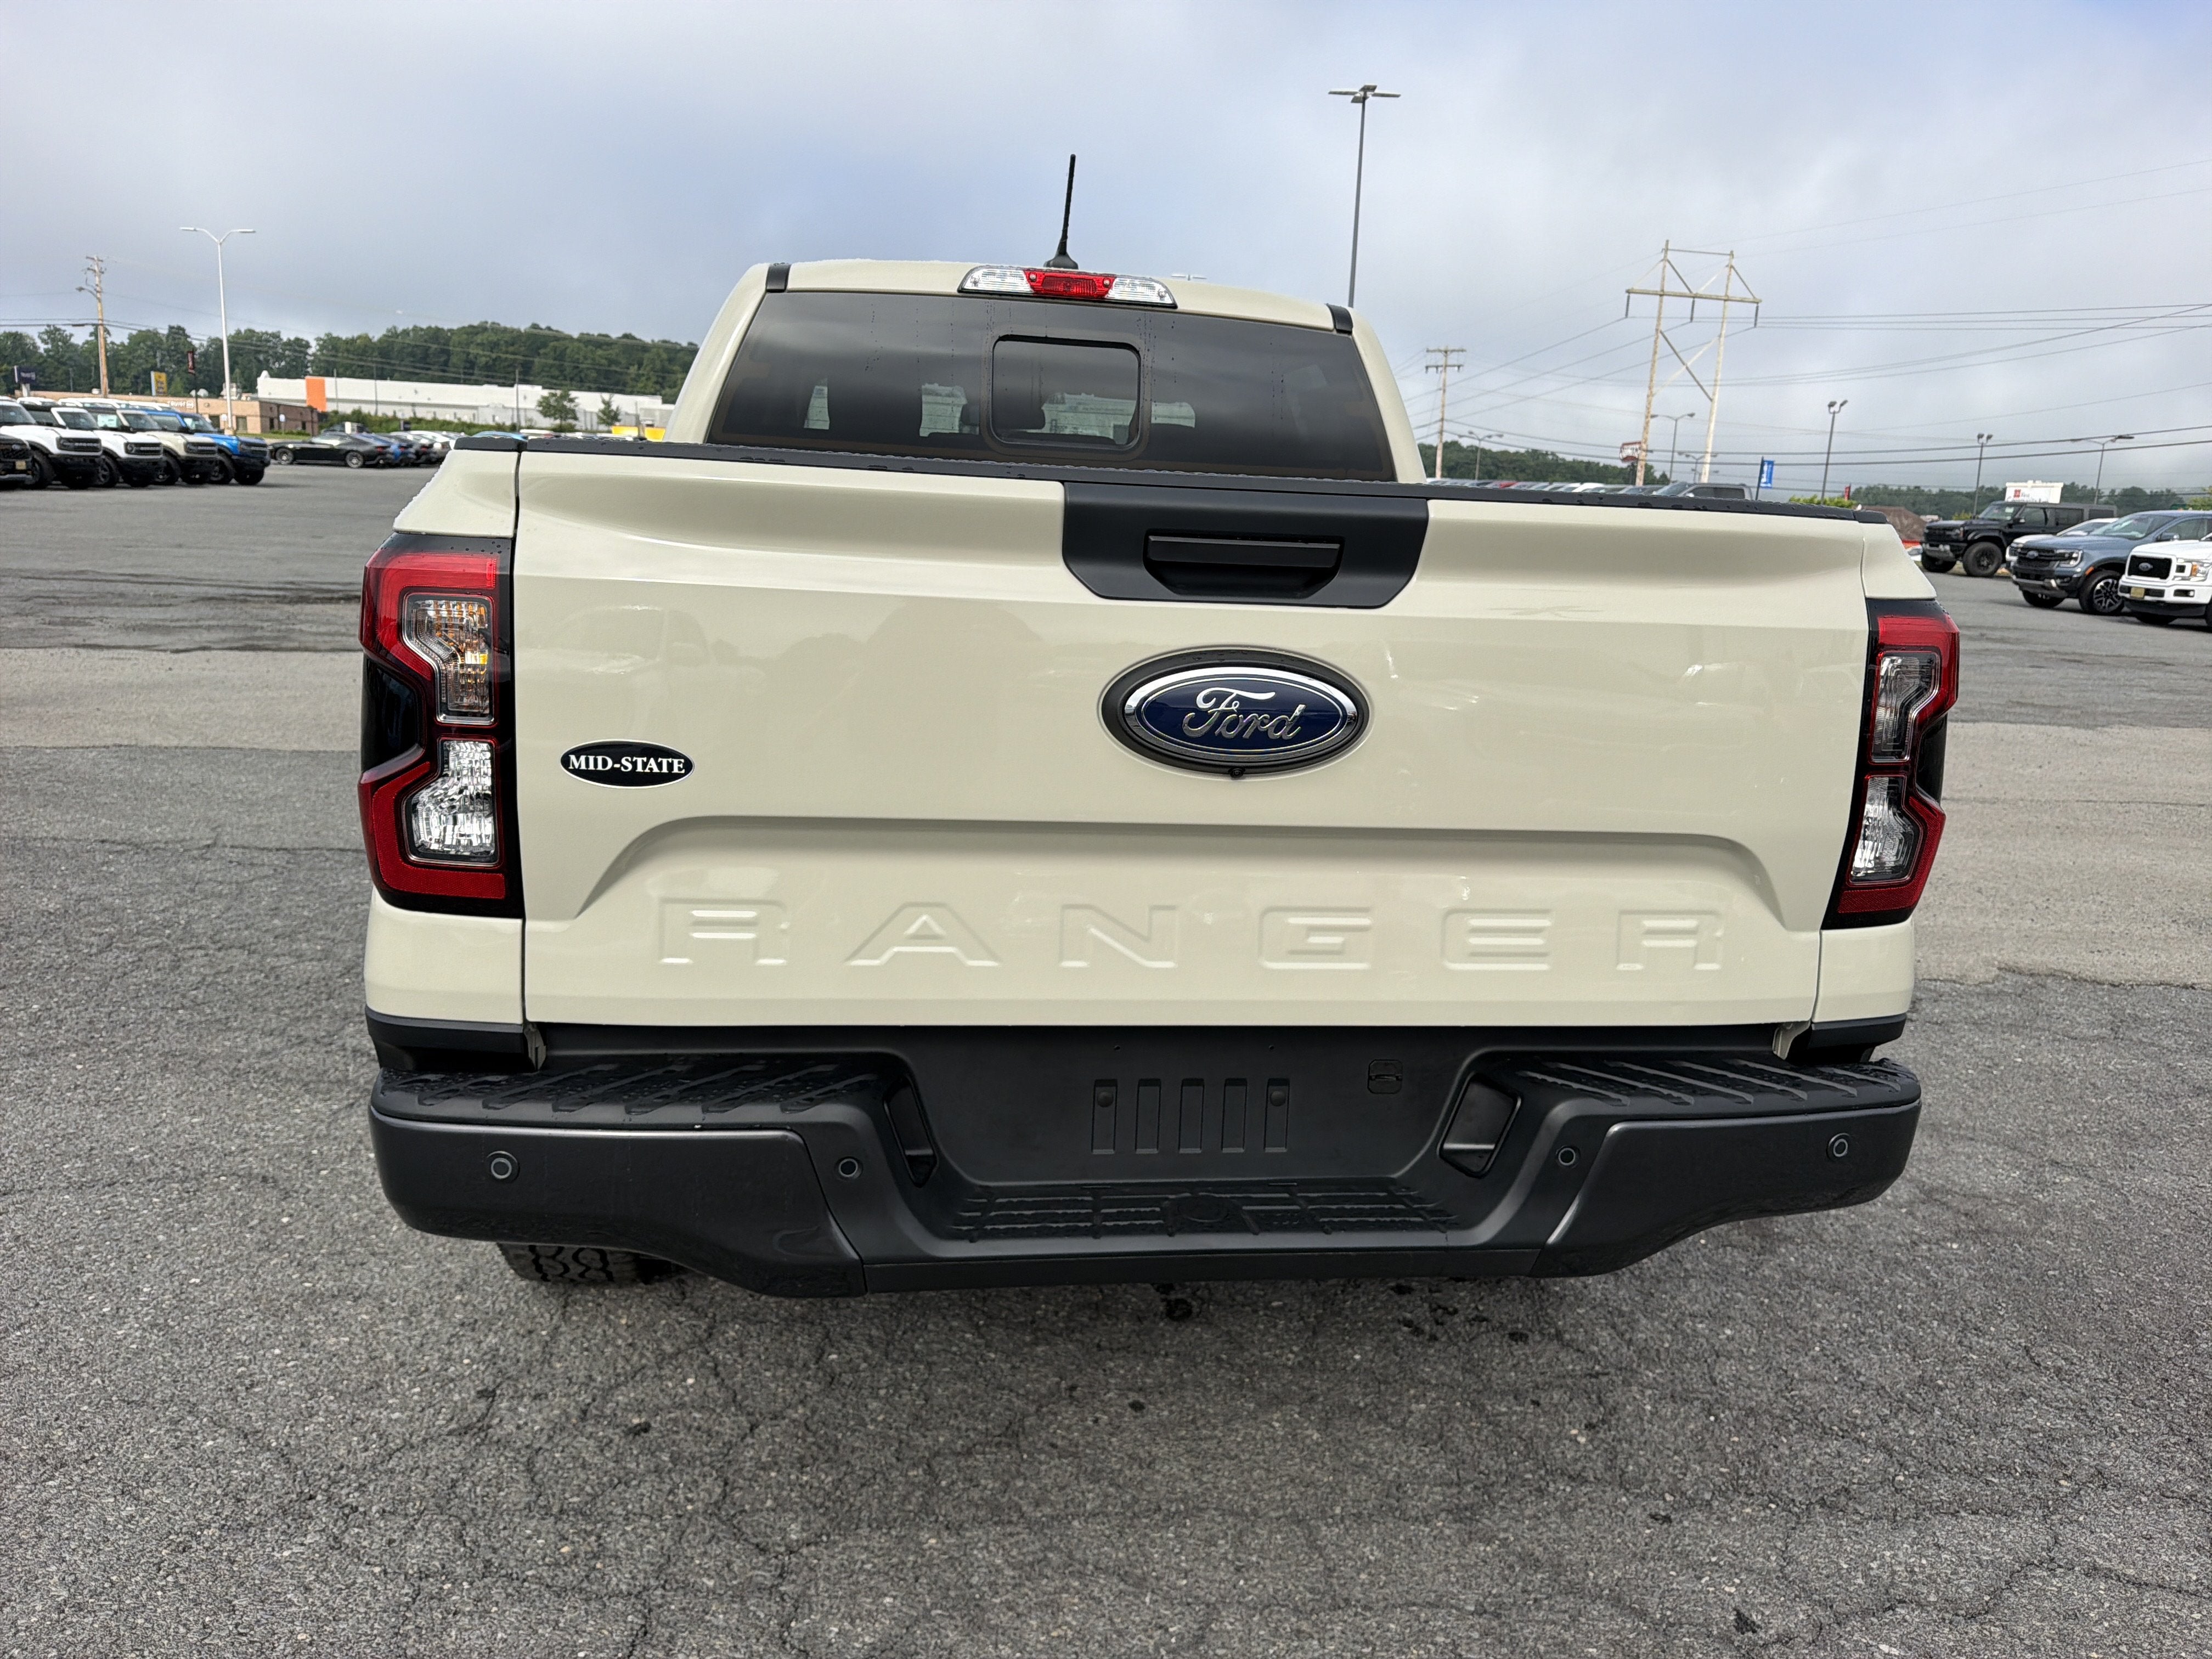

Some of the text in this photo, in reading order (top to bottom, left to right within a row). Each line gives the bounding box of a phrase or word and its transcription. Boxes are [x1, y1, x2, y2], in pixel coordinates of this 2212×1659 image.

[1182, 687, 1307, 741] Ford
[568, 754, 686, 774] MID-STATE
[659, 897, 1722, 970] RANGER
